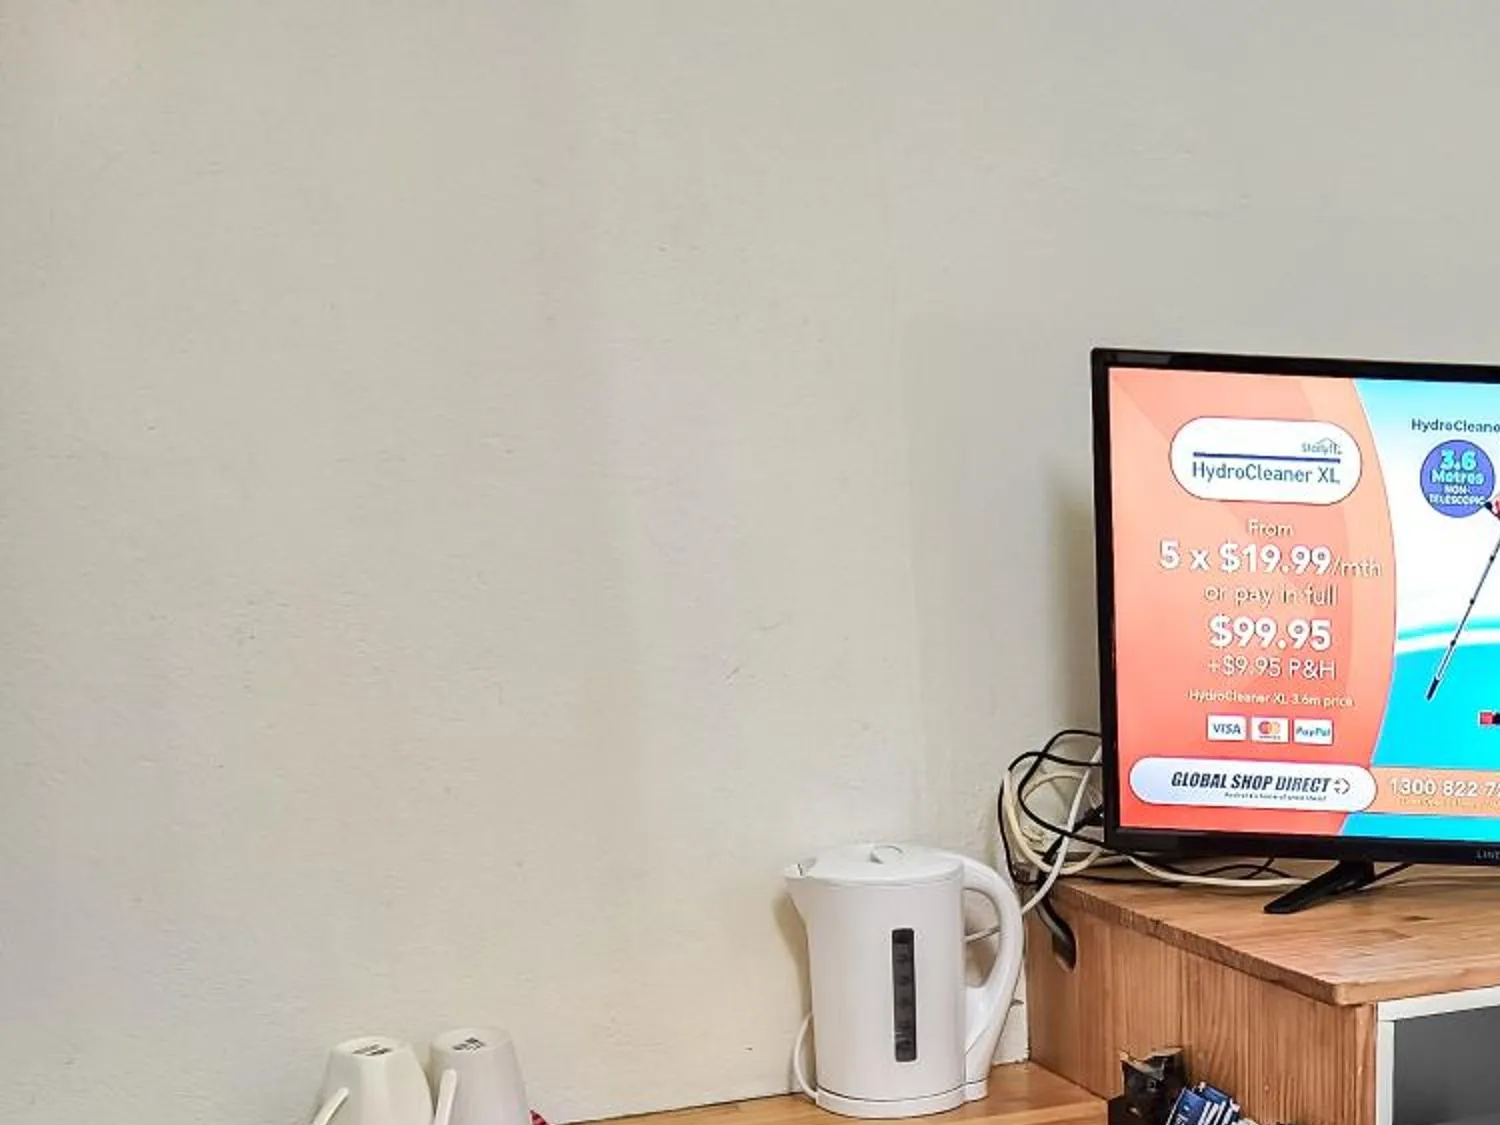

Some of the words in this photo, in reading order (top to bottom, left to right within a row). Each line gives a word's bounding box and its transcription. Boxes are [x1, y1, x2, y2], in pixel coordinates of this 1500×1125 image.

[1440, 448, 1478, 471] 3.6
[1192, 462, 1313, 482] HydroCleaner
[1317, 467, 1341, 484] XL
[1248, 519, 1294, 537] From
[1160, 540, 1180, 570] 5
[1190, 548, 1210, 571] x
[1235, 588, 1274, 608] pay
[1304, 585, 1339, 606] full
[1209, 613, 1332, 651] $99.95
[1208, 655, 1282, 677] +$9.95
[1289, 658, 1336, 680] P&H
[1213, 723, 1241, 735] VISA
[1296, 727, 1331, 738] PayPal
[1172, 771, 1228, 789] GLOBAL
[1231, 773, 1274, 791] SHOP
[1275, 775, 1332, 793] DIRECT
[1391, 777, 1437, 797] 1300
[1442, 779, 1478, 797] 822
